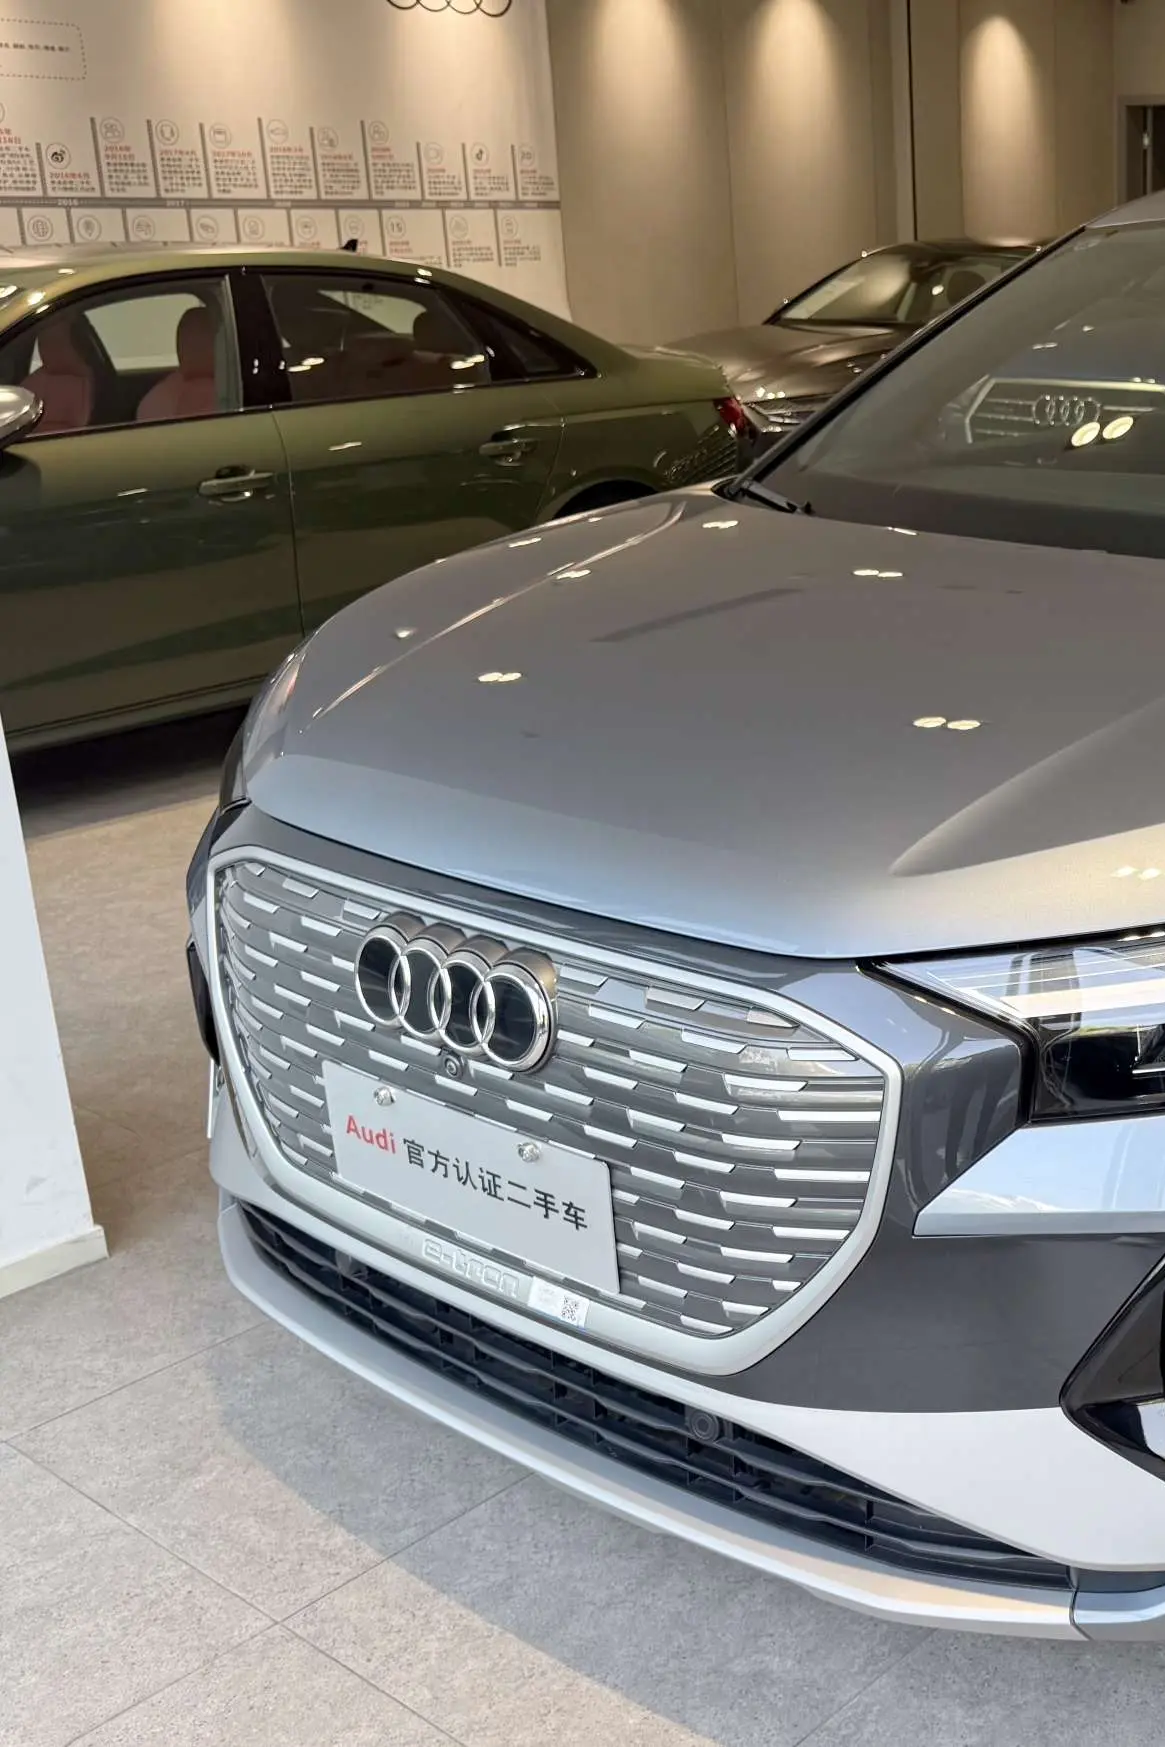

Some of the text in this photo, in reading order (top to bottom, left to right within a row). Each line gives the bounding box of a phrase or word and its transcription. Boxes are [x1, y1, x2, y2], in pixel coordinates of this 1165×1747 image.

[346, 1114, 588, 1231] Audi 官方认证二手车
[422, 1238, 520, 1299] e-tron
